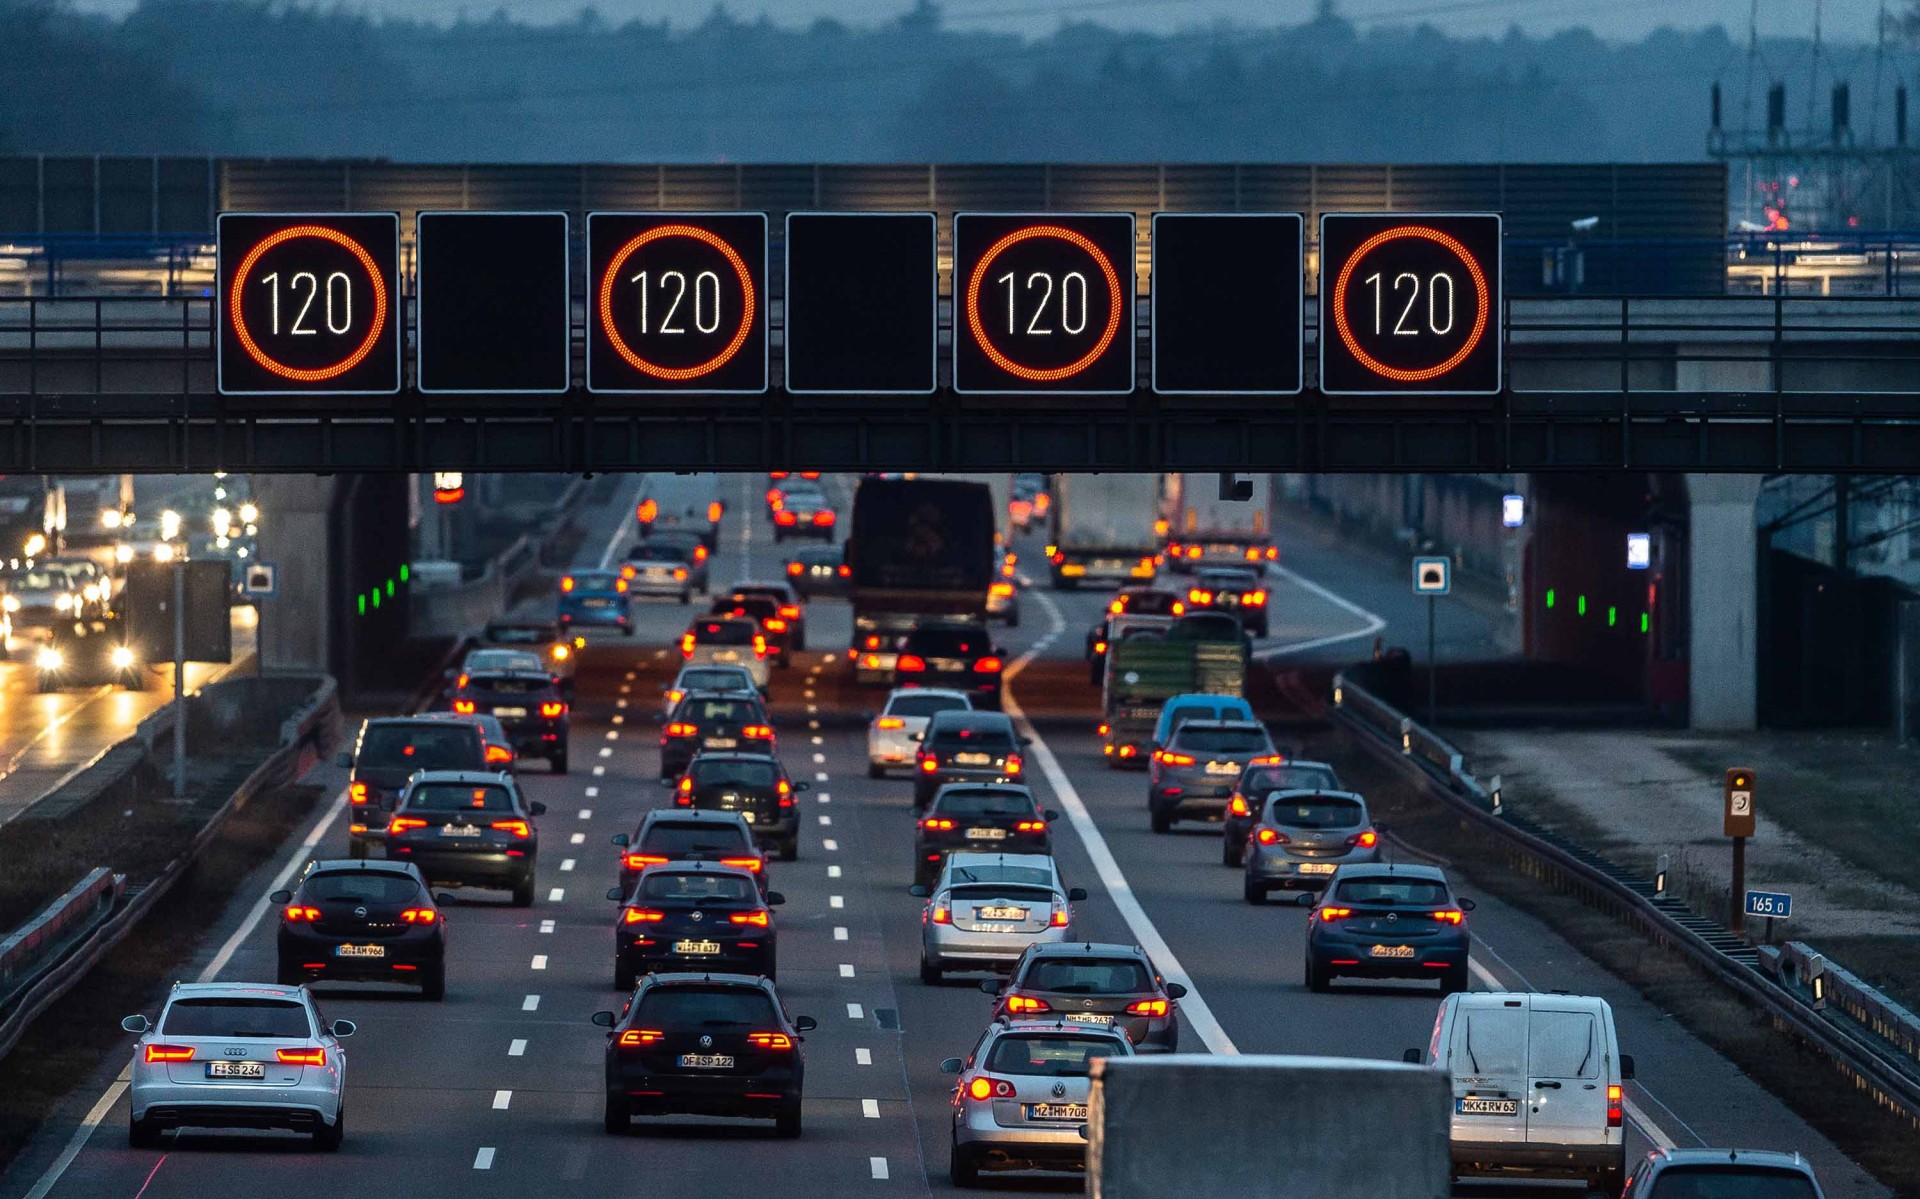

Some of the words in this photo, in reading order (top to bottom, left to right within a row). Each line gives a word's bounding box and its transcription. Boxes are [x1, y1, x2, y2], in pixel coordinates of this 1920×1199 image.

[262, 271, 352, 335] 120
[631, 271, 720, 335] 120
[998, 271, 1087, 335] 120
[1365, 272, 1454, 335] 120
[242, 1065, 261, 1076] 234
[715, 1057, 733, 1067] 122
[1068, 1107, 1087, 1118] 708
[1503, 1102, 1516, 1112] 63
